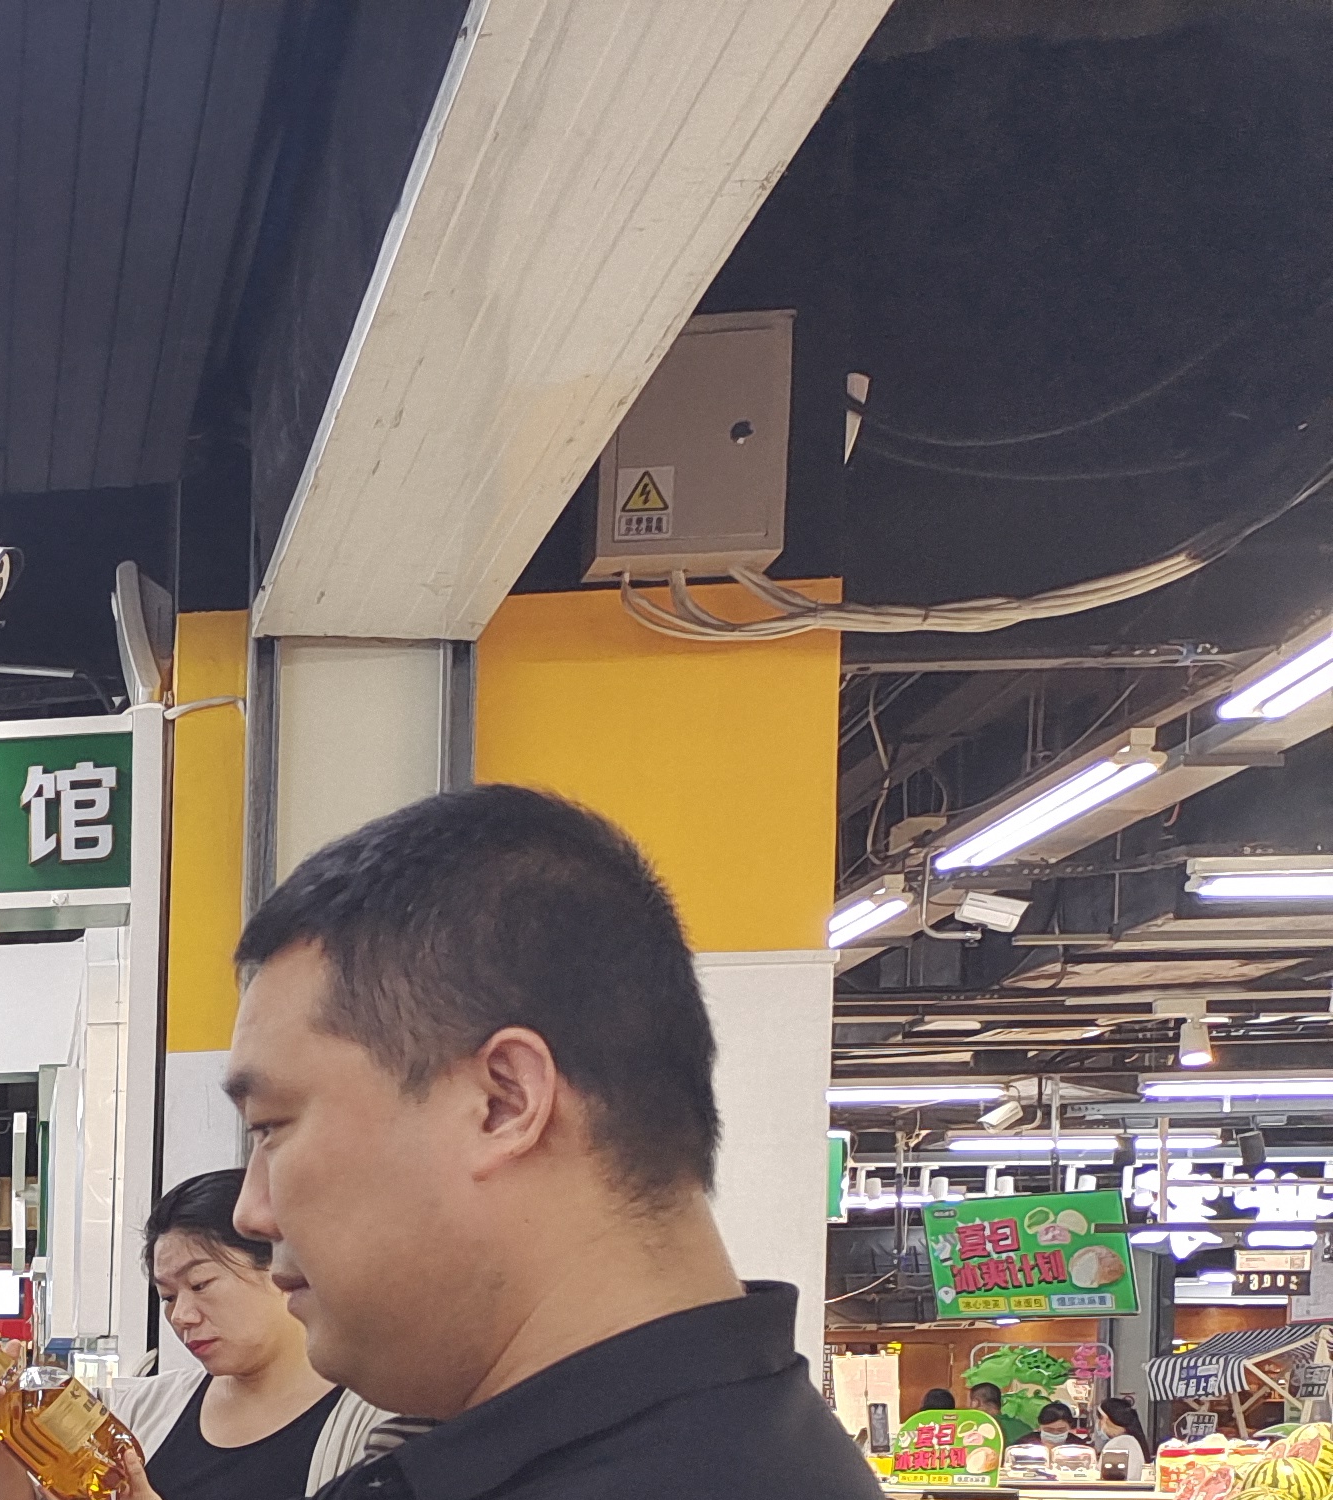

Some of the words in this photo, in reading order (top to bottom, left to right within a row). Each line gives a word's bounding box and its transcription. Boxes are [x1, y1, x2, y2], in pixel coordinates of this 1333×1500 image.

[955, 1218, 1021, 1261] 夏日
[950, 1249, 1068, 1295] 冰爽计划
